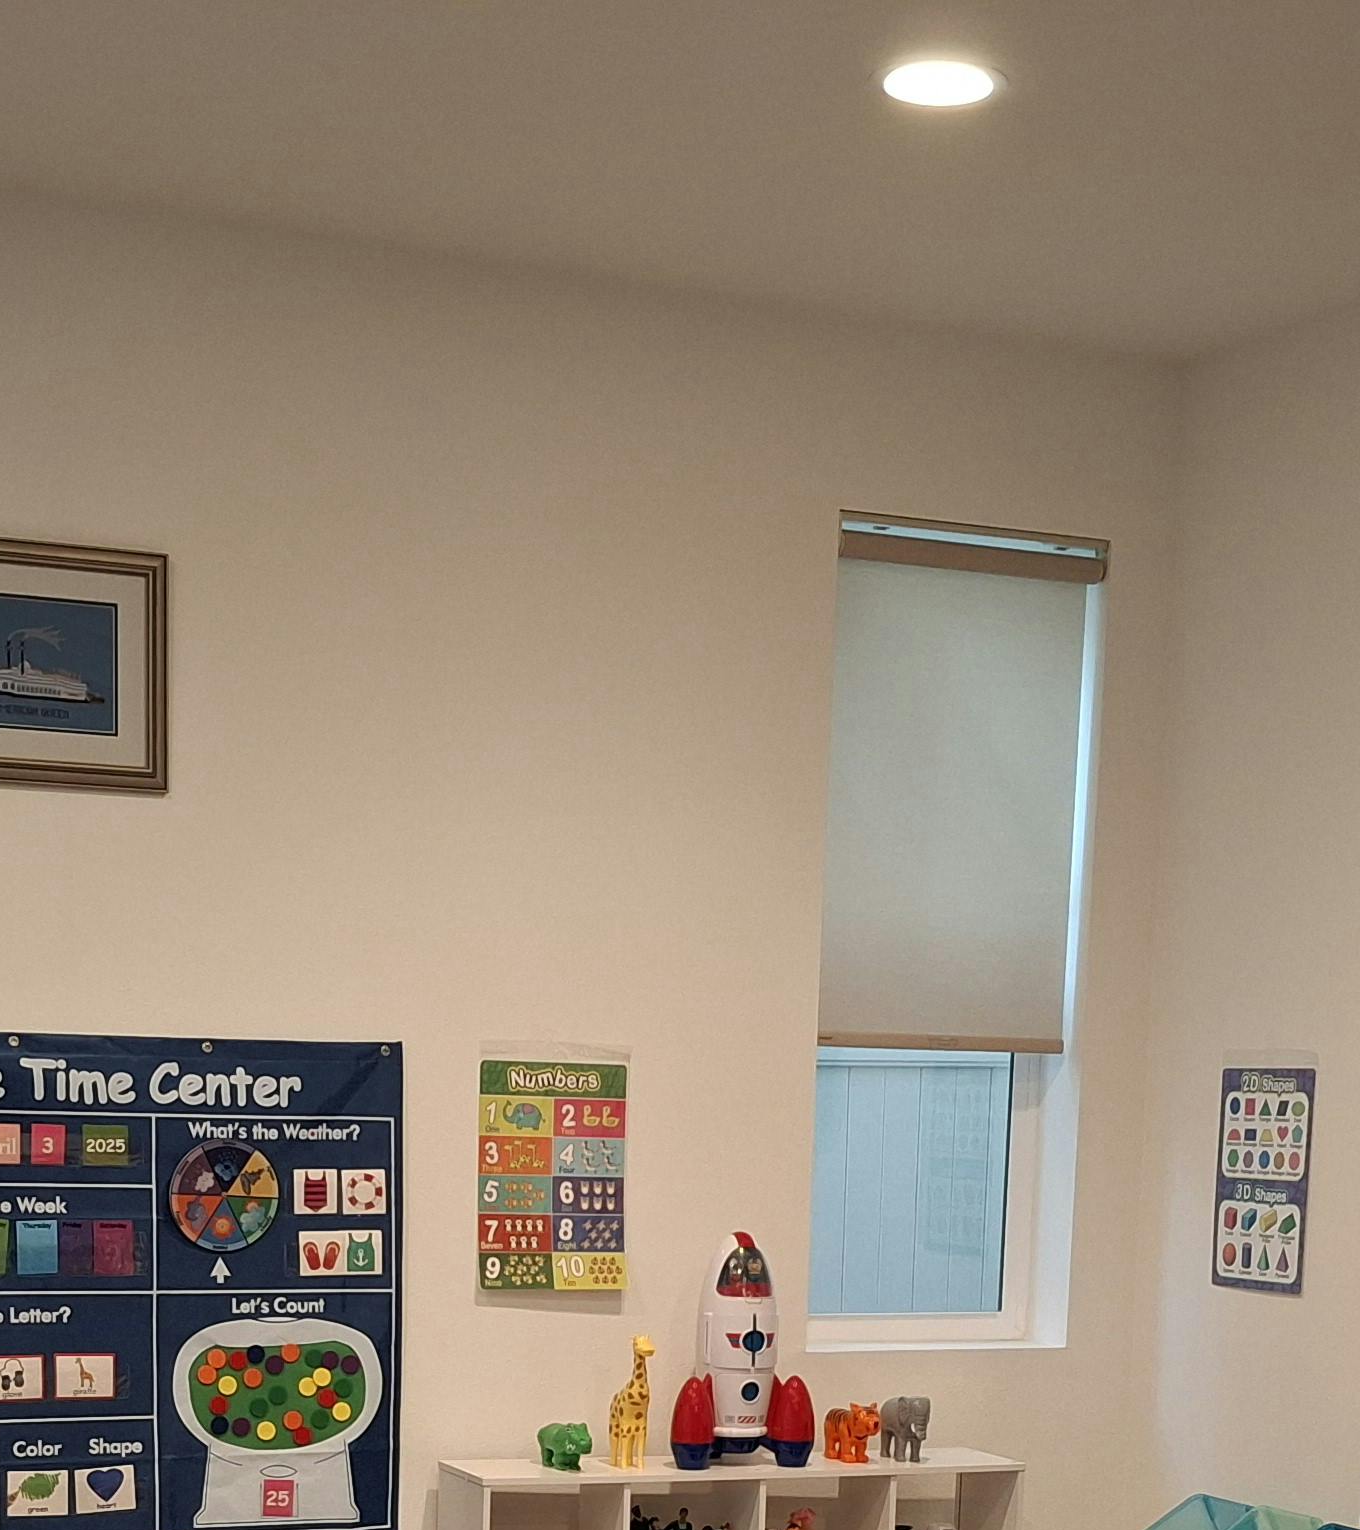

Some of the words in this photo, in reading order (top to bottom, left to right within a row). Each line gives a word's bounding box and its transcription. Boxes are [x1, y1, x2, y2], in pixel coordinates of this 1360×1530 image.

[20, 1057, 136, 1105] Time
[149, 1062, 302, 1108] Center
[509, 1068, 599, 1090] Numbers
[1242, 1074, 1259, 1092] 2D
[1262, 1078, 1295, 1096] Shapes
[486, 1101, 497, 1124] 1
[561, 1104, 576, 1127] 2
[188, 1121, 247, 1140] What's
[253, 1122, 279, 1141] the
[284, 1124, 360, 1143] Weather?
[42, 1138, 54, 1154] 3
[86, 1138, 126, 1154] 2025
[484, 1141, 499, 1165] 3
[559, 1143, 575, 1166] 4
[483, 1180, 499, 1202] 5
[559, 1181, 574, 1204] 6
[1235, 1183, 1251, 1199] 3D
[1254, 1187, 1287, 1204] Shapes
[16, 1196, 67, 1214] Week
[484, 1220, 499, 1242] 7
[558, 1218, 574, 1241] 8
[484, 1256, 501, 1279] 9
[556, 1255, 585, 1279] 10
[9, 1305, 71, 1324] Letter?
[231, 1297, 269, 1315] Let's
[271, 1298, 325, 1315] Count
[13, 1440, 62, 1457] Color
[89, 1438, 143, 1458] Shape
[265, 1490, 290, 1507] 25
